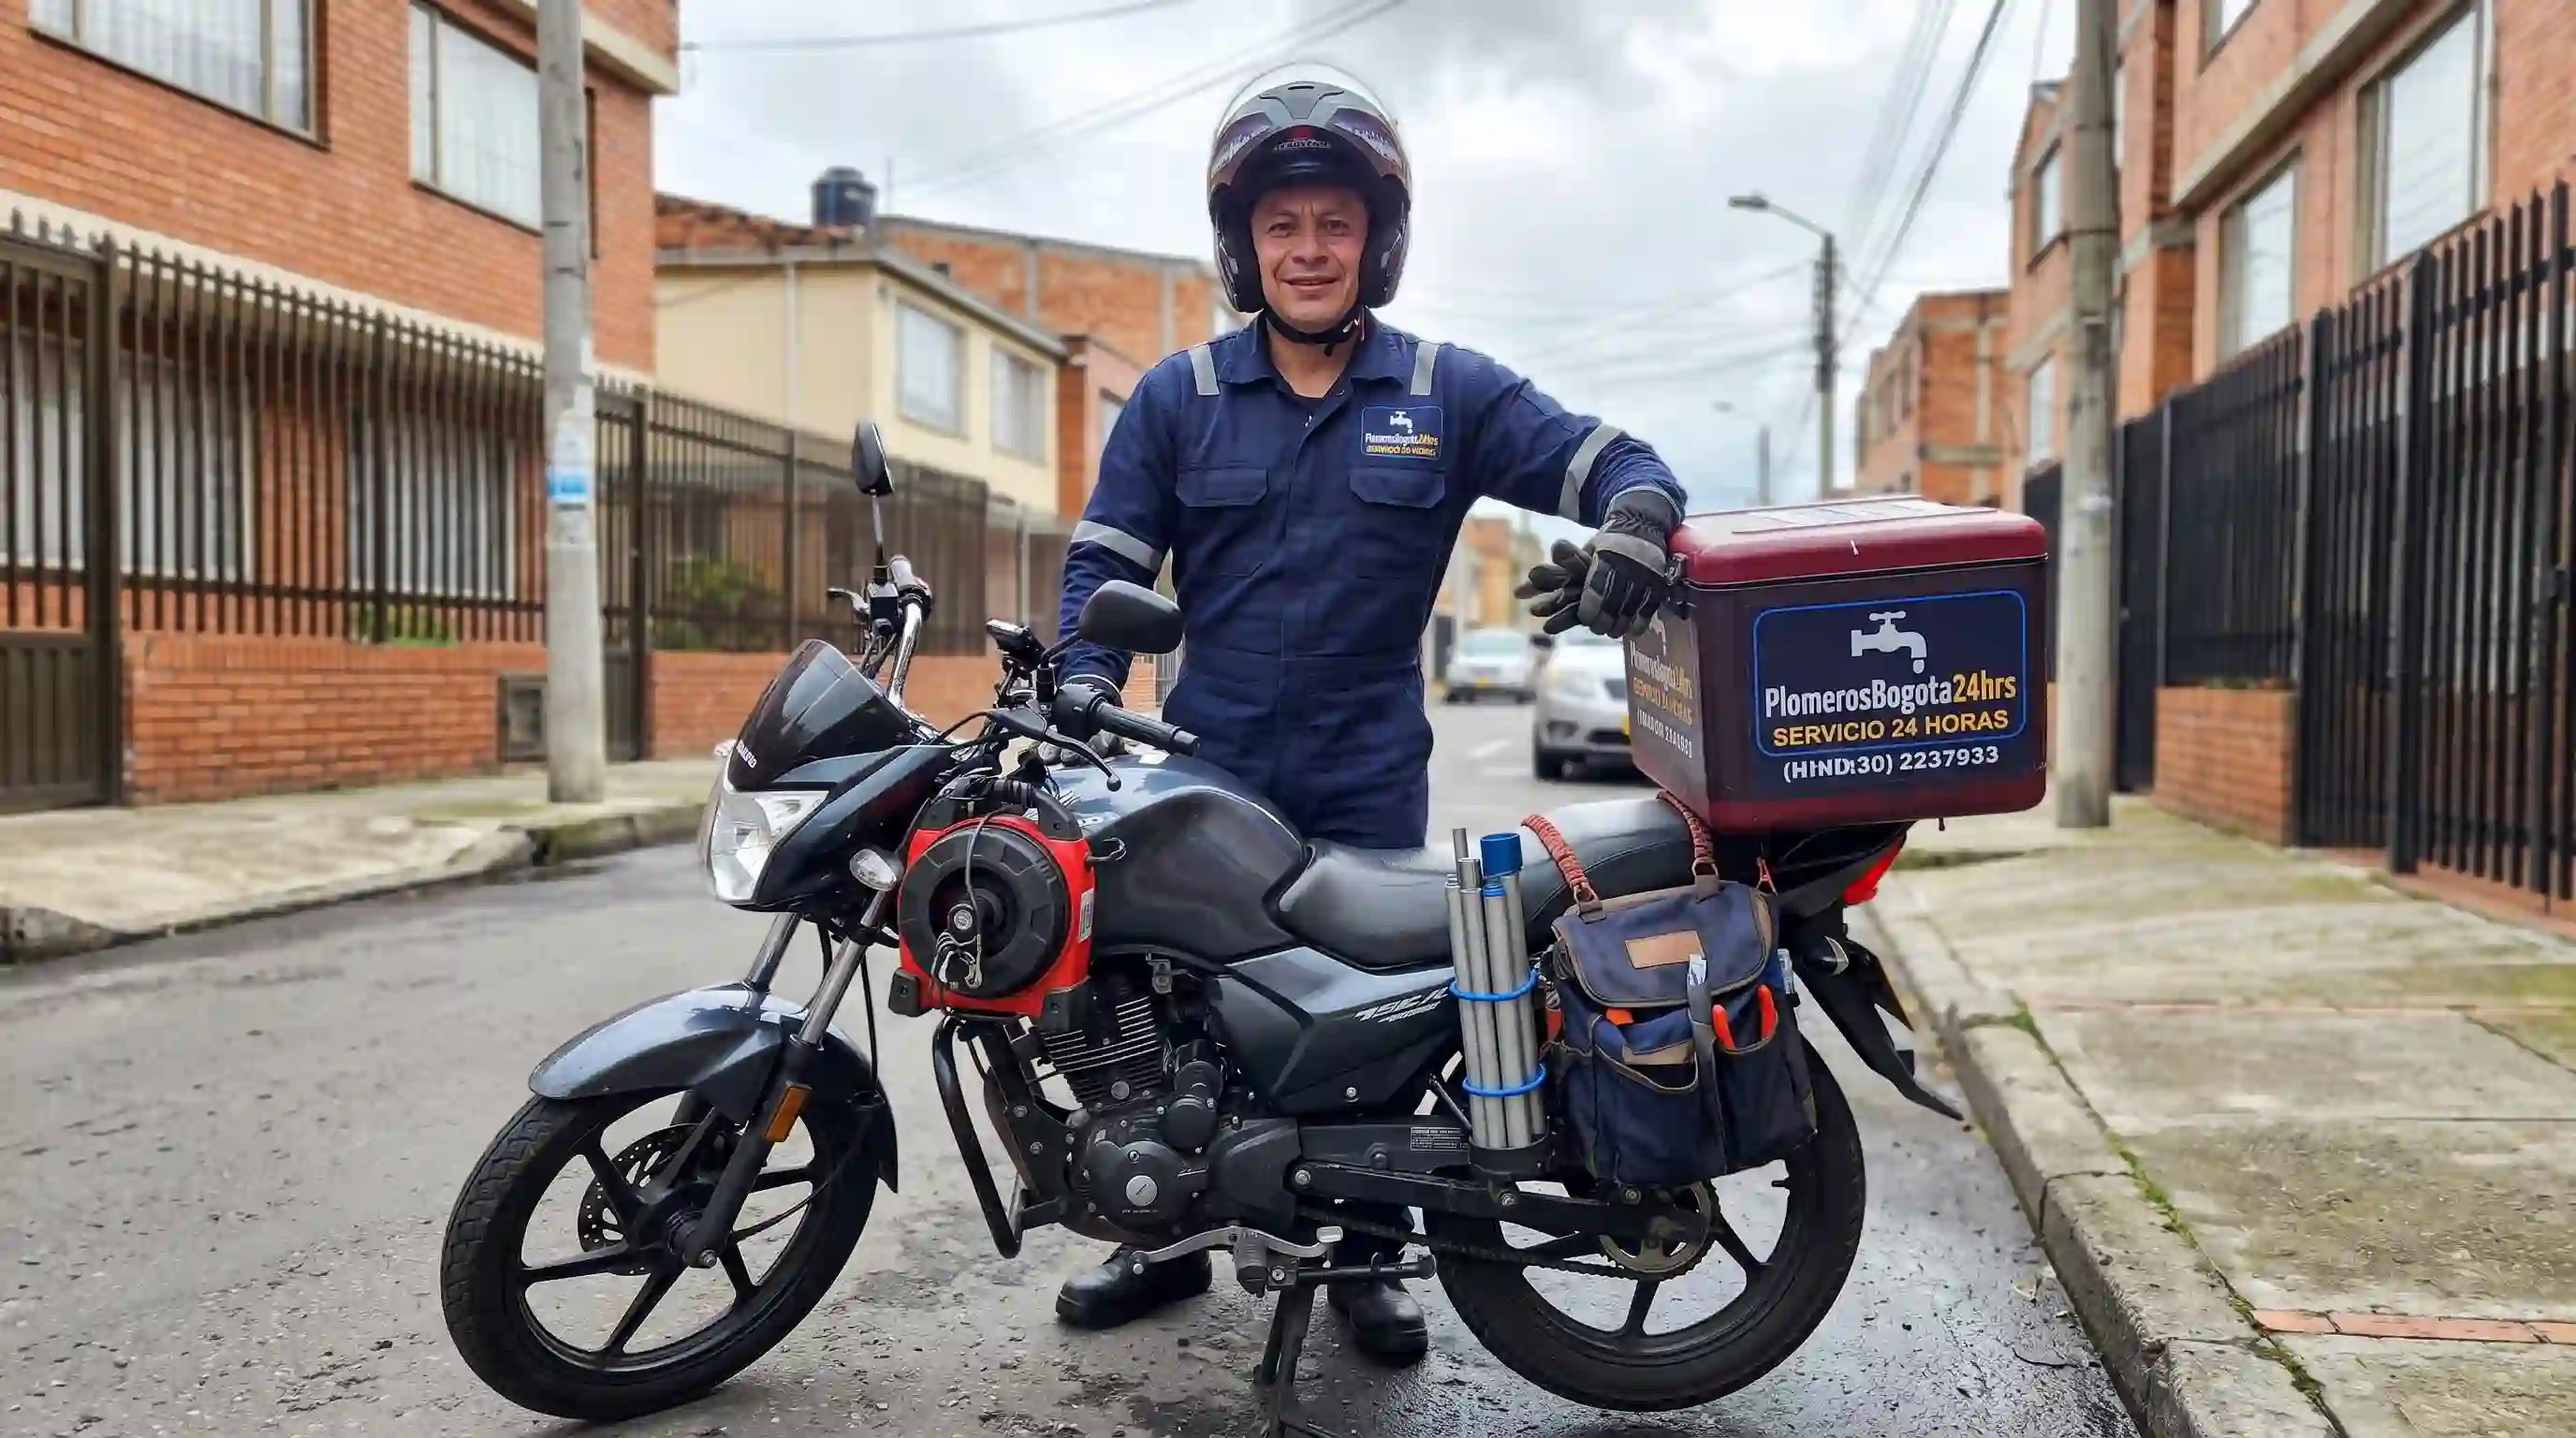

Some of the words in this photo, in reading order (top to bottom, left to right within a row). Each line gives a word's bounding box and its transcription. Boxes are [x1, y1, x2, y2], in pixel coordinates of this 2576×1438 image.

[1765, 670, 2016, 718] PlomerosBogota24hrs
[1773, 720, 1884, 747] SERVICIO
[1891, 718, 1918, 738] 24
[1925, 710, 2009, 735] HORAS
[1899, 746, 1999, 771] 2237933
